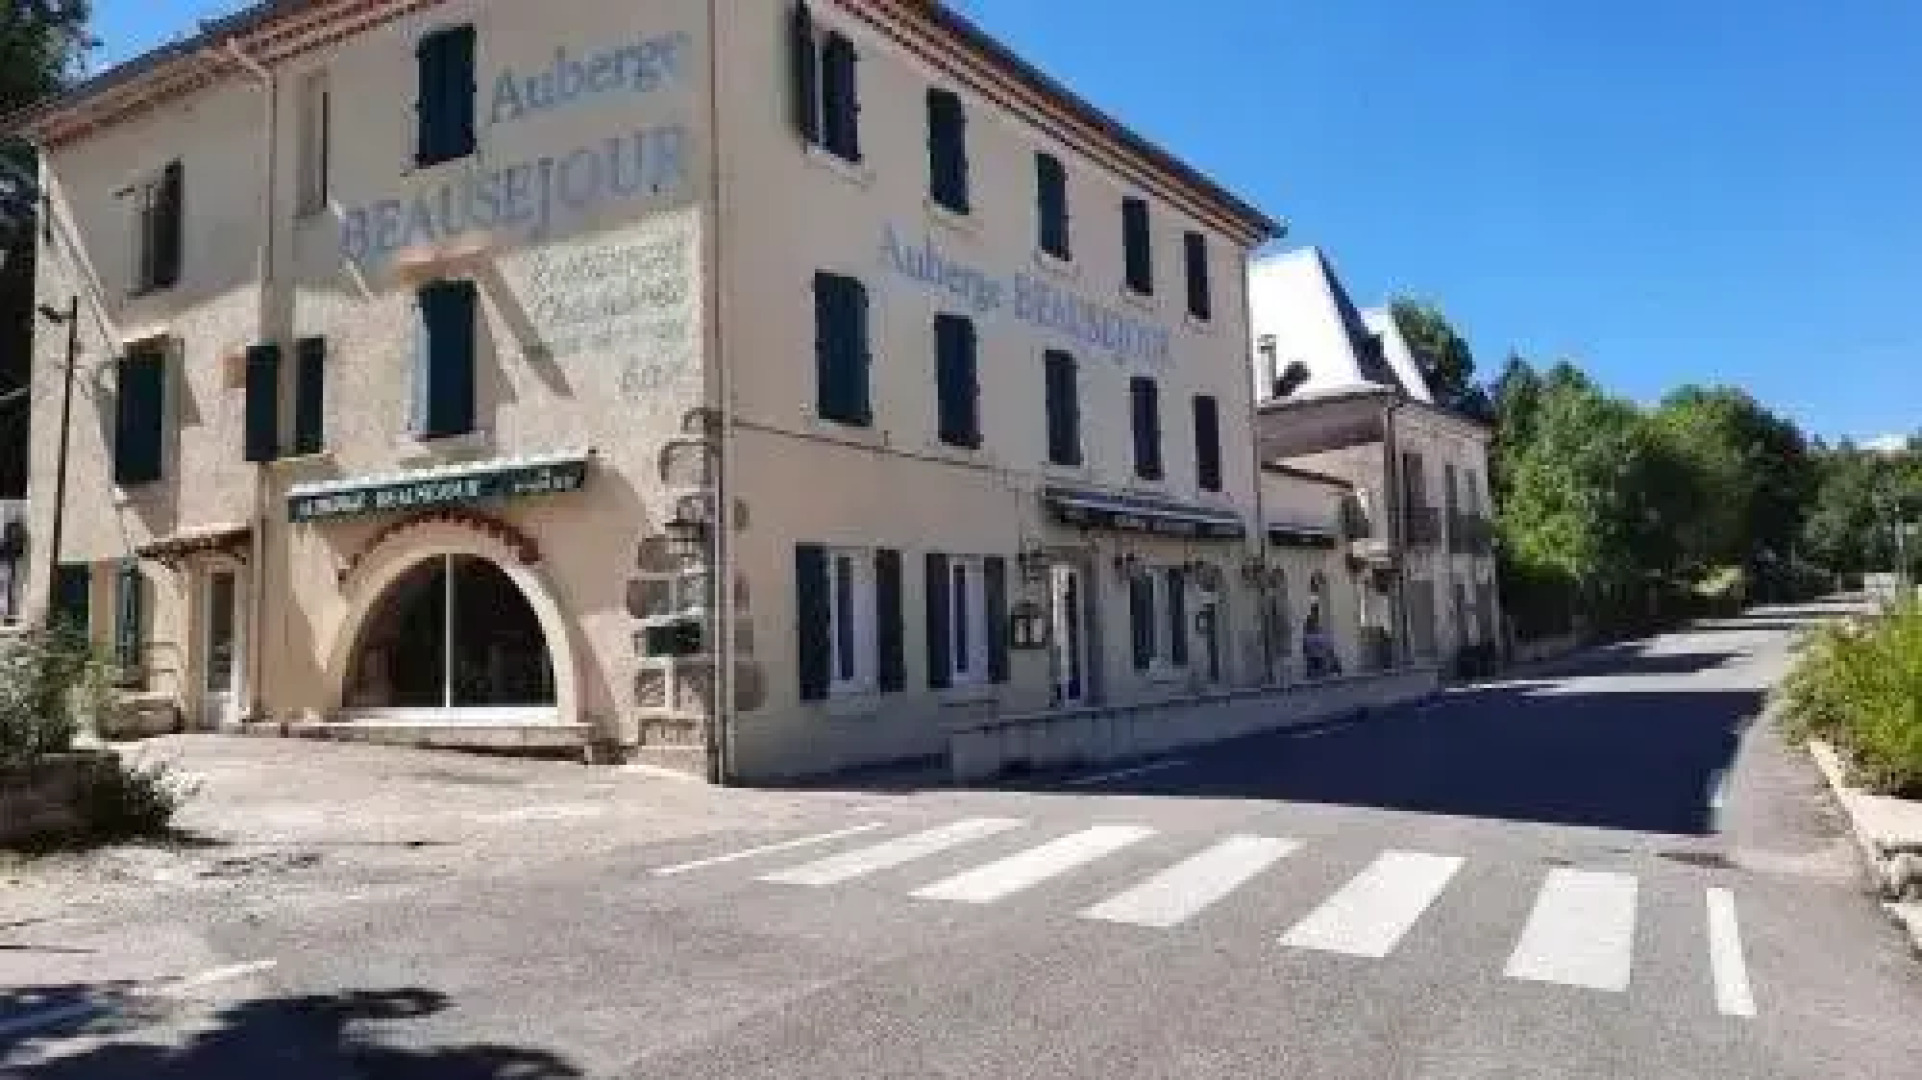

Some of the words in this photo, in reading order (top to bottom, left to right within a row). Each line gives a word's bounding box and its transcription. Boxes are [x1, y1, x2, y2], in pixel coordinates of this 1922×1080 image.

[338, 125, 688, 261] BEAUSEJOUR
[876, 222, 1001, 312] Auberge
[1013, 271, 1173, 364] BEAUSEJOUR
